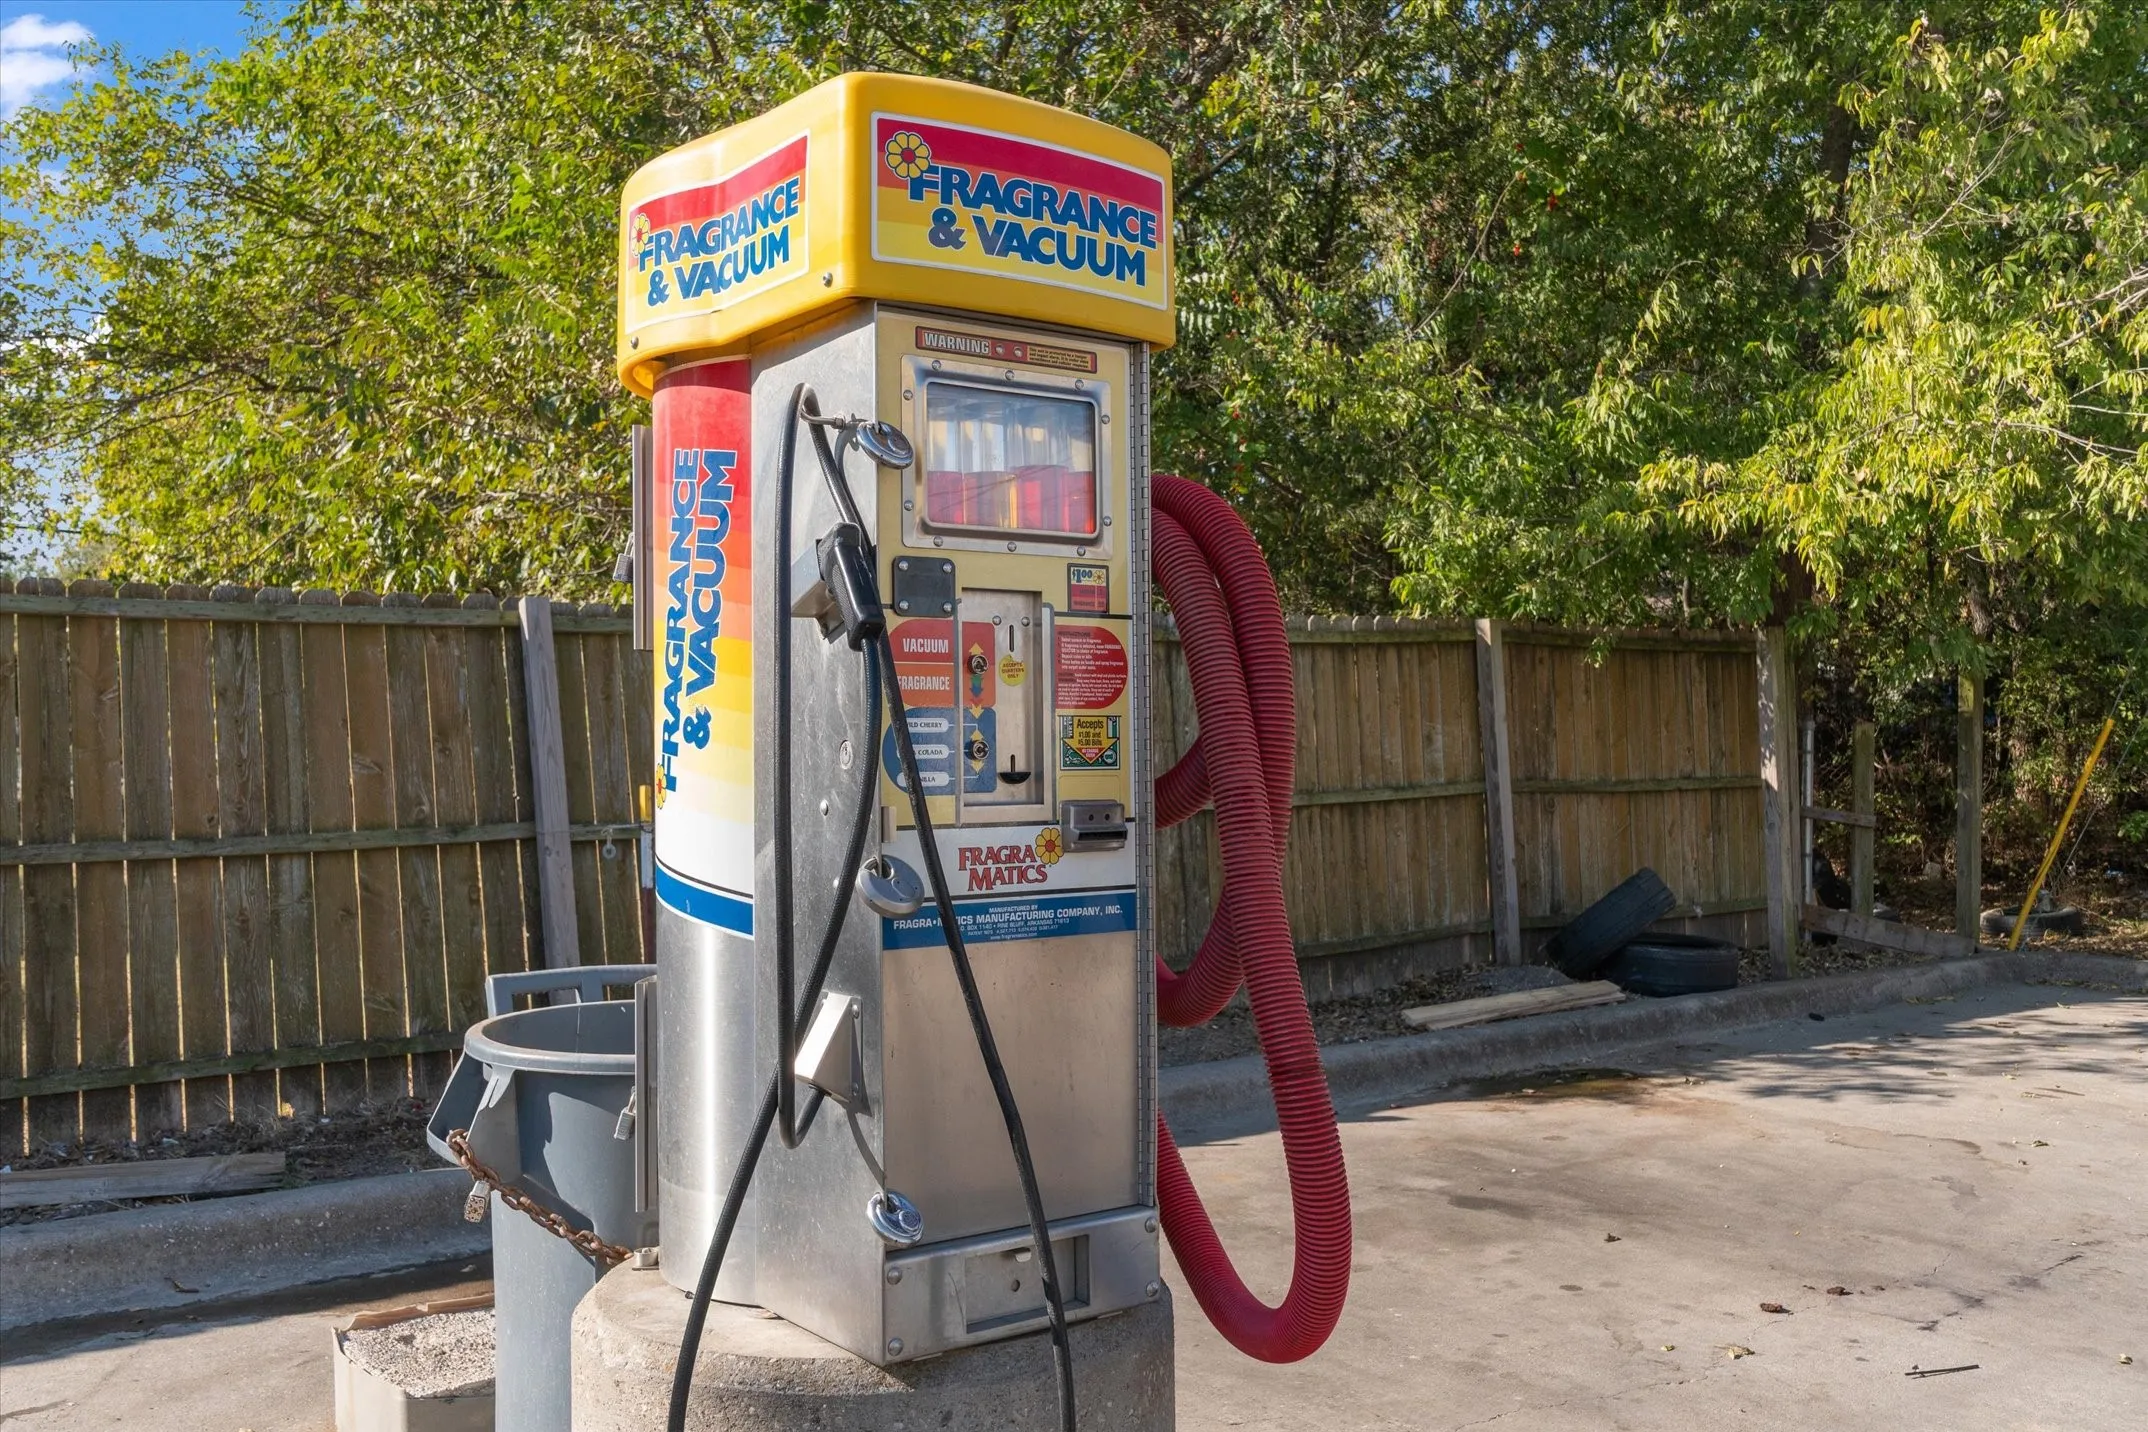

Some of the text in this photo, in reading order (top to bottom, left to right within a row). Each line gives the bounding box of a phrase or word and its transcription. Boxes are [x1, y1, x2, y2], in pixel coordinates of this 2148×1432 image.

[908, 163, 1158, 250] FRAGRANCE
[638, 176, 801, 273] FRAGRANCE
[928, 207, 1148, 288] & VACUUM
[647, 223, 791, 307] & VACUUM
[924, 332, 990, 355] WARNING
[682, 448, 737, 751] & VACUUM
[663, 447, 700, 794] FRAGRANCE
[902, 638, 949, 654] VACUUM
[896, 676, 950, 690] FRAGRANCE
[1077, 719, 1104, 730] Accepts
[1092, 730, 1101, 738] and
[958, 844, 1037, 871] FRAGRA
[967, 864, 1049, 892] MATICS
[976, 909, 1054, 923] MANUFACTURING
[1057, 906, 1103, 918] COMPANY,
[1105, 905, 1123, 914] INC.
[989, 905, 1030, 913] MANUFACTURED
